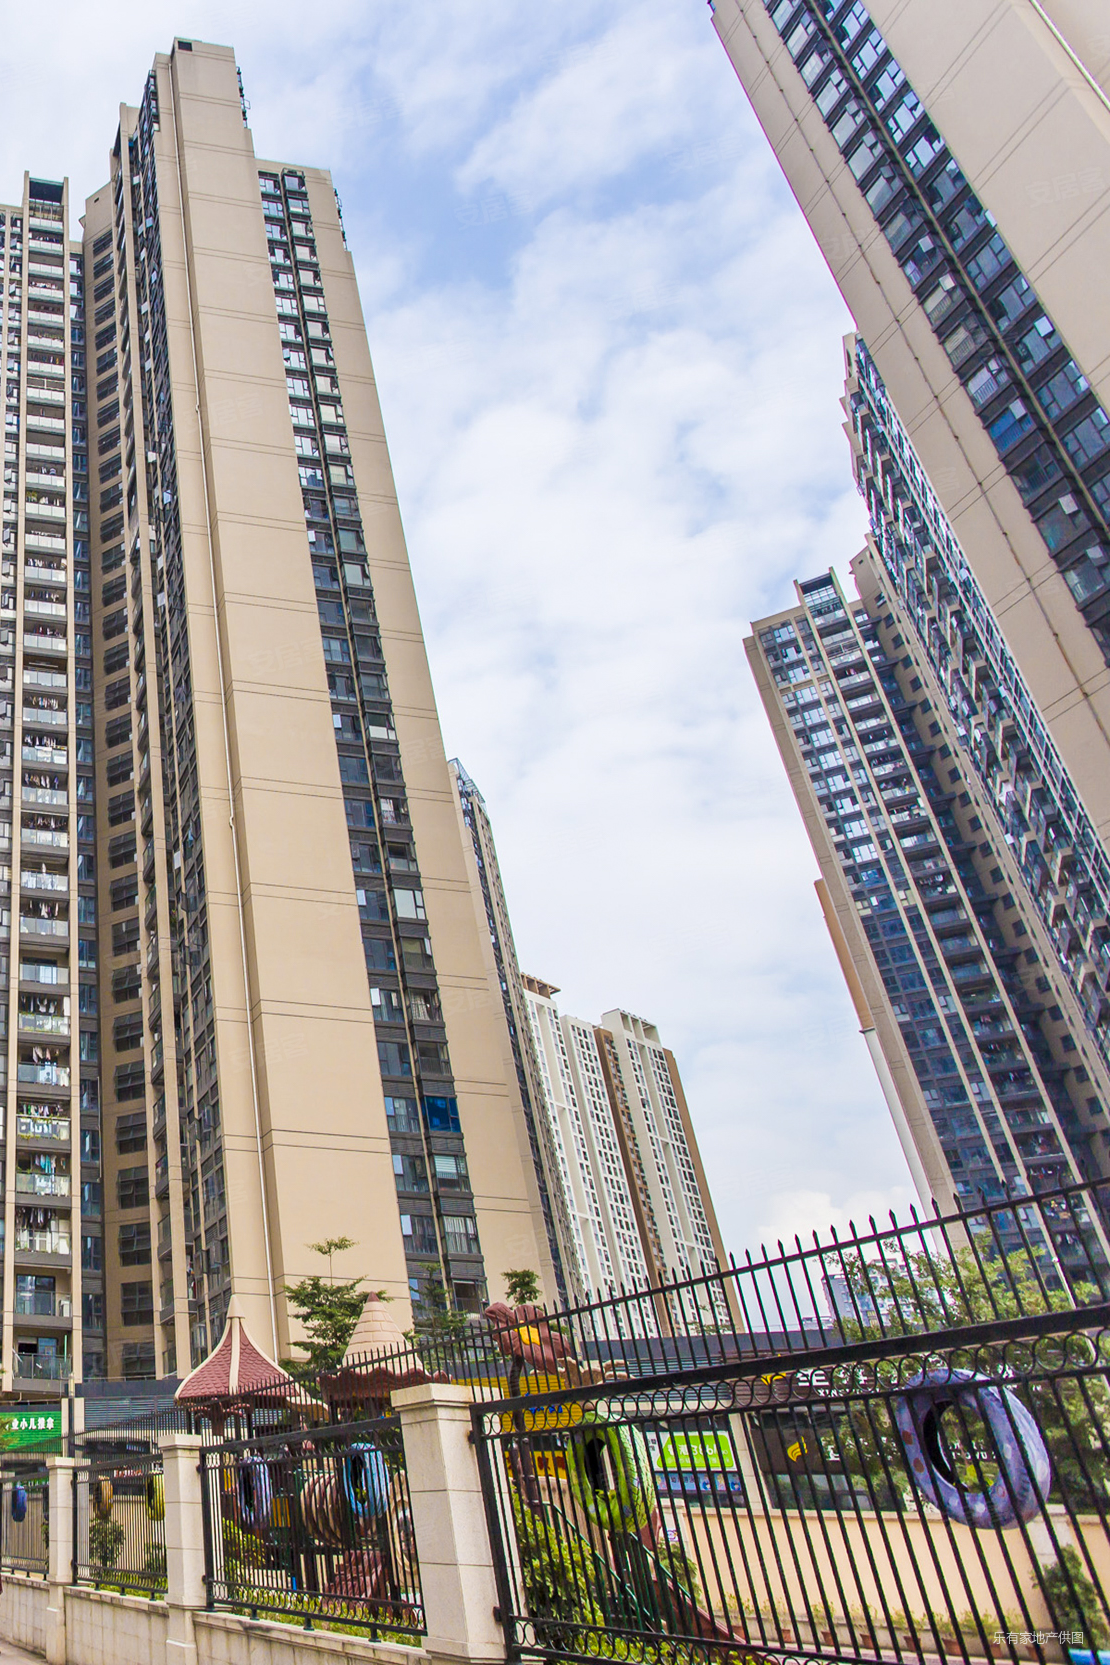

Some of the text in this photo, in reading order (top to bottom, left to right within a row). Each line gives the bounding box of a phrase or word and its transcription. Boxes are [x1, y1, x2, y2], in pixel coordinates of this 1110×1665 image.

[5, 1416, 54, 1430] 业小儿推拿
